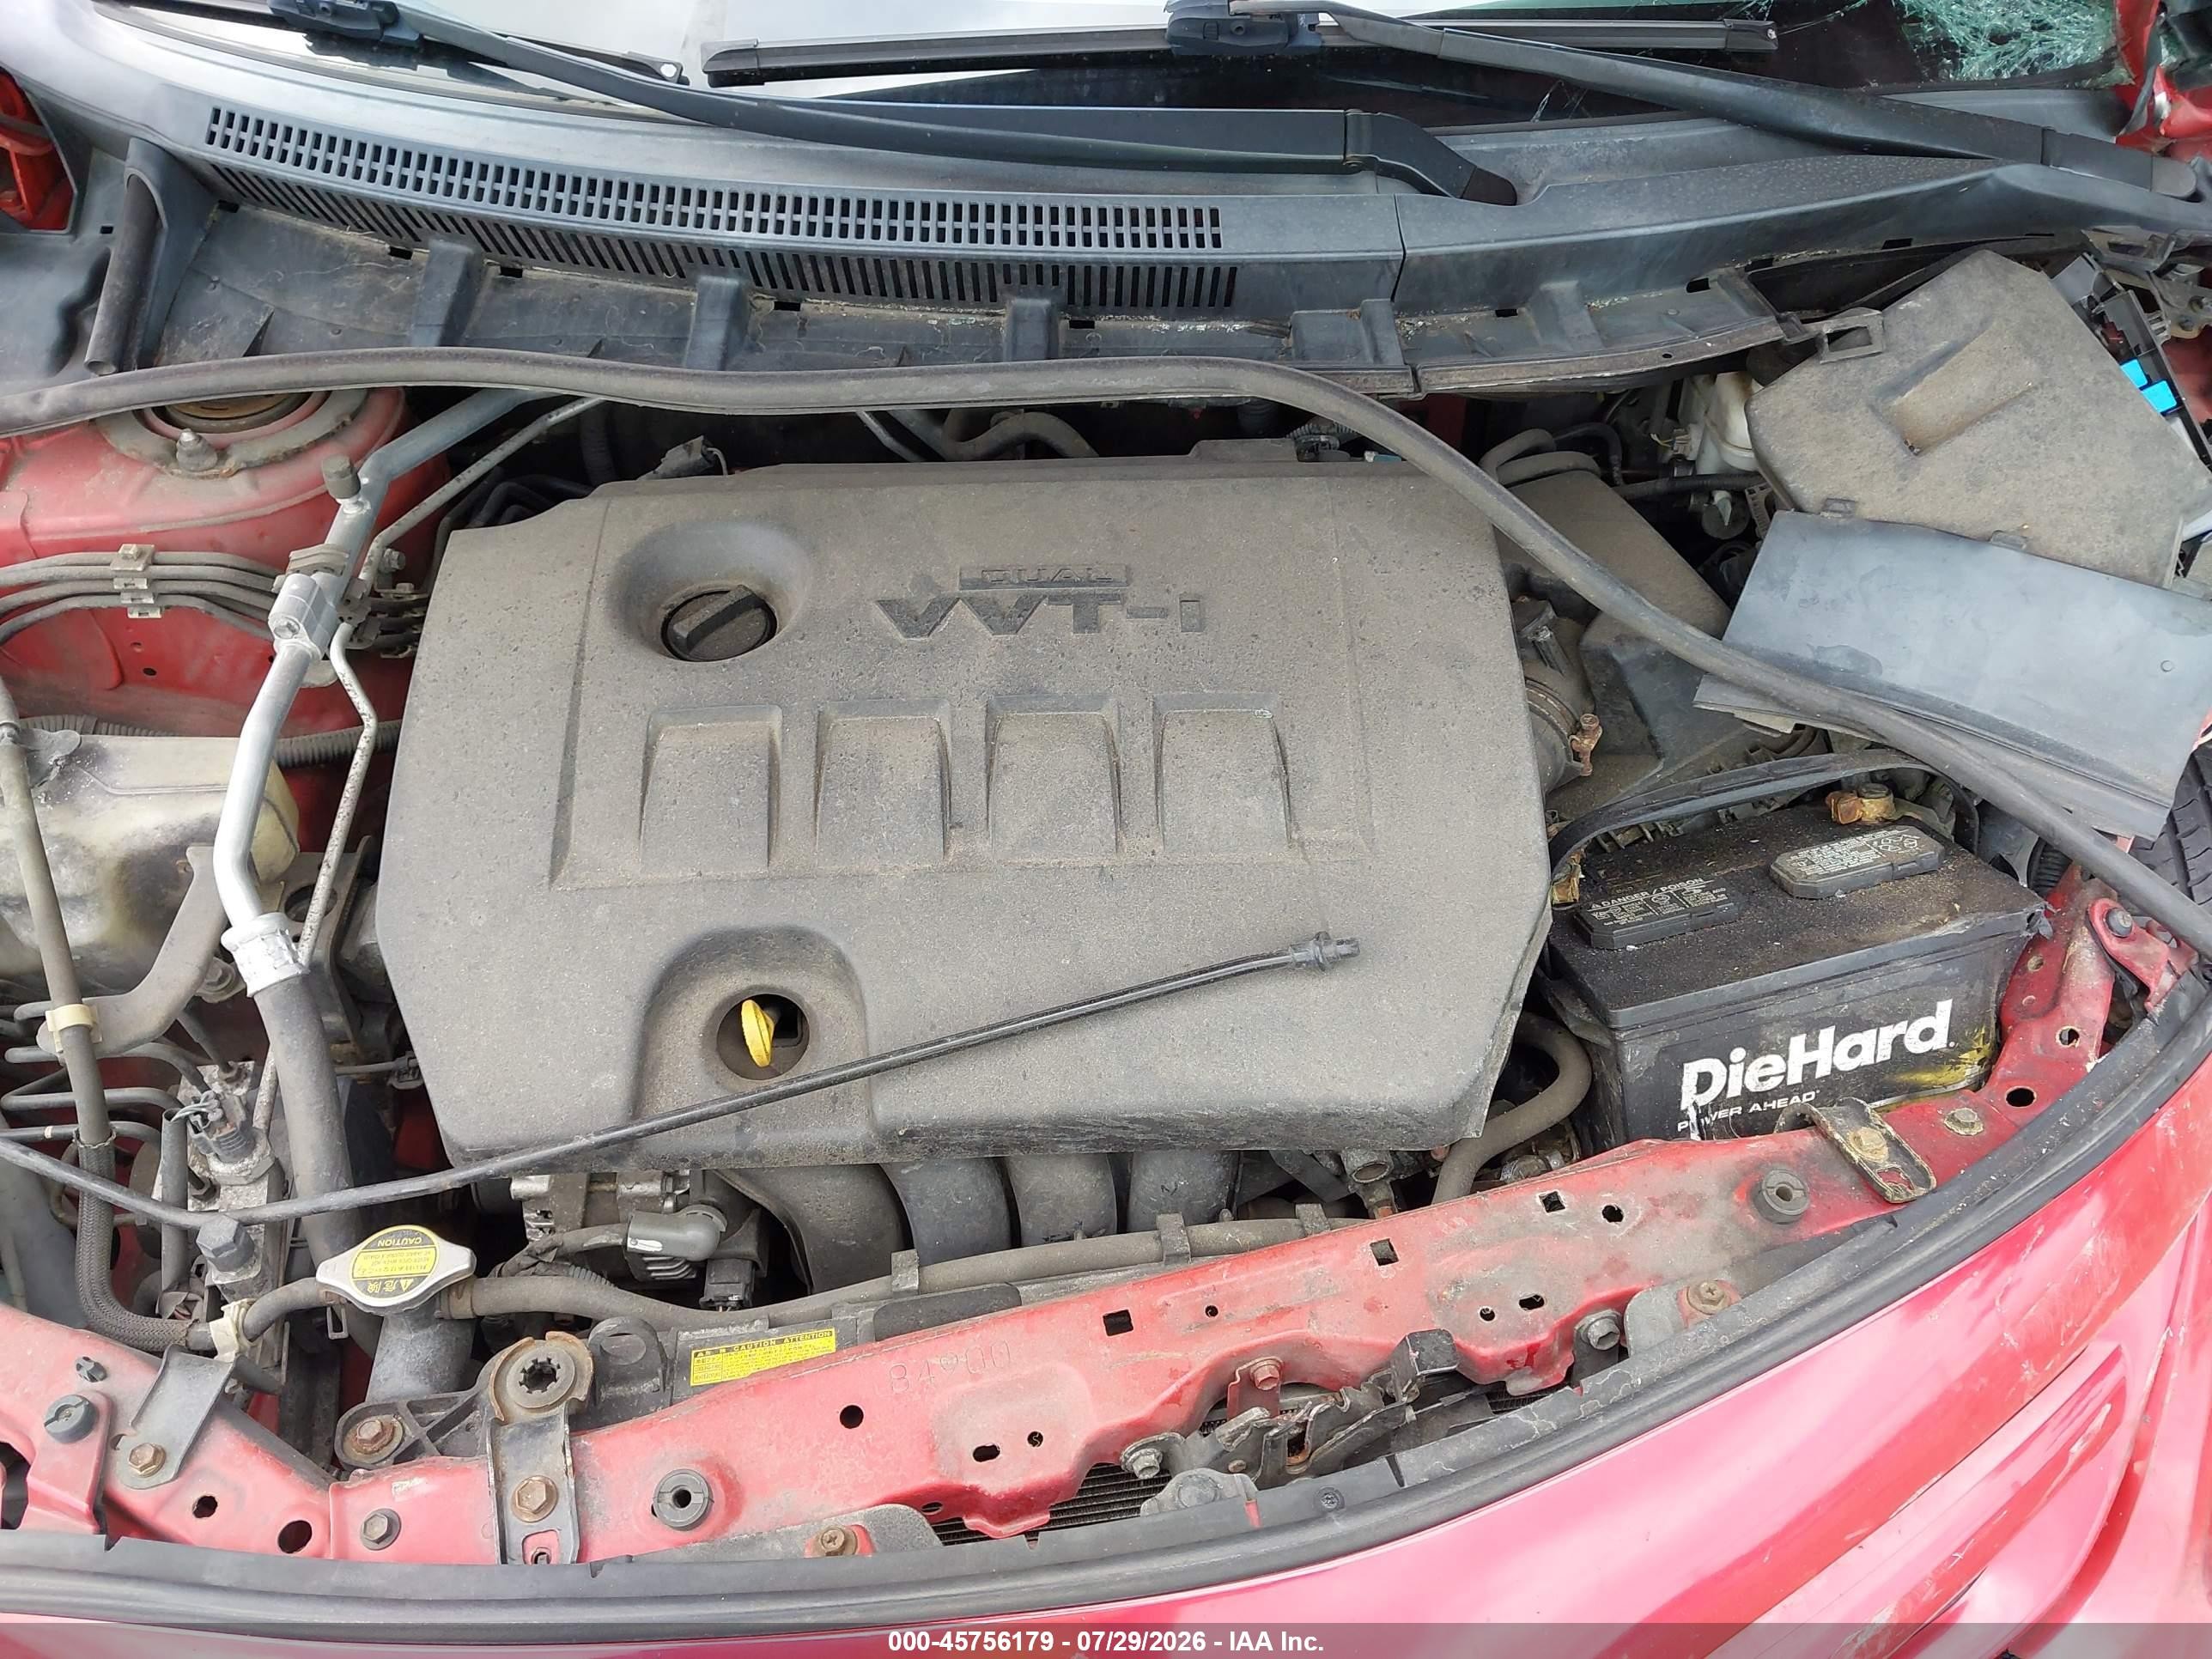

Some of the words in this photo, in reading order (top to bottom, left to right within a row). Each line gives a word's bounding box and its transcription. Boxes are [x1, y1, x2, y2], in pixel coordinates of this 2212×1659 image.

[981, 567, 1114, 584] DUAL
[1601, 891, 1650, 907] DANGER
[1660, 878, 1705, 892] POISON
[1680, 999, 1954, 1110] DieHard
[1747, 1091, 1814, 1114] AHEAD
[378, 1237, 422, 1247] CAUTION
[733, 1340, 776, 1352] CAUTION
[783, 1331, 830, 1344] ATTENTION
